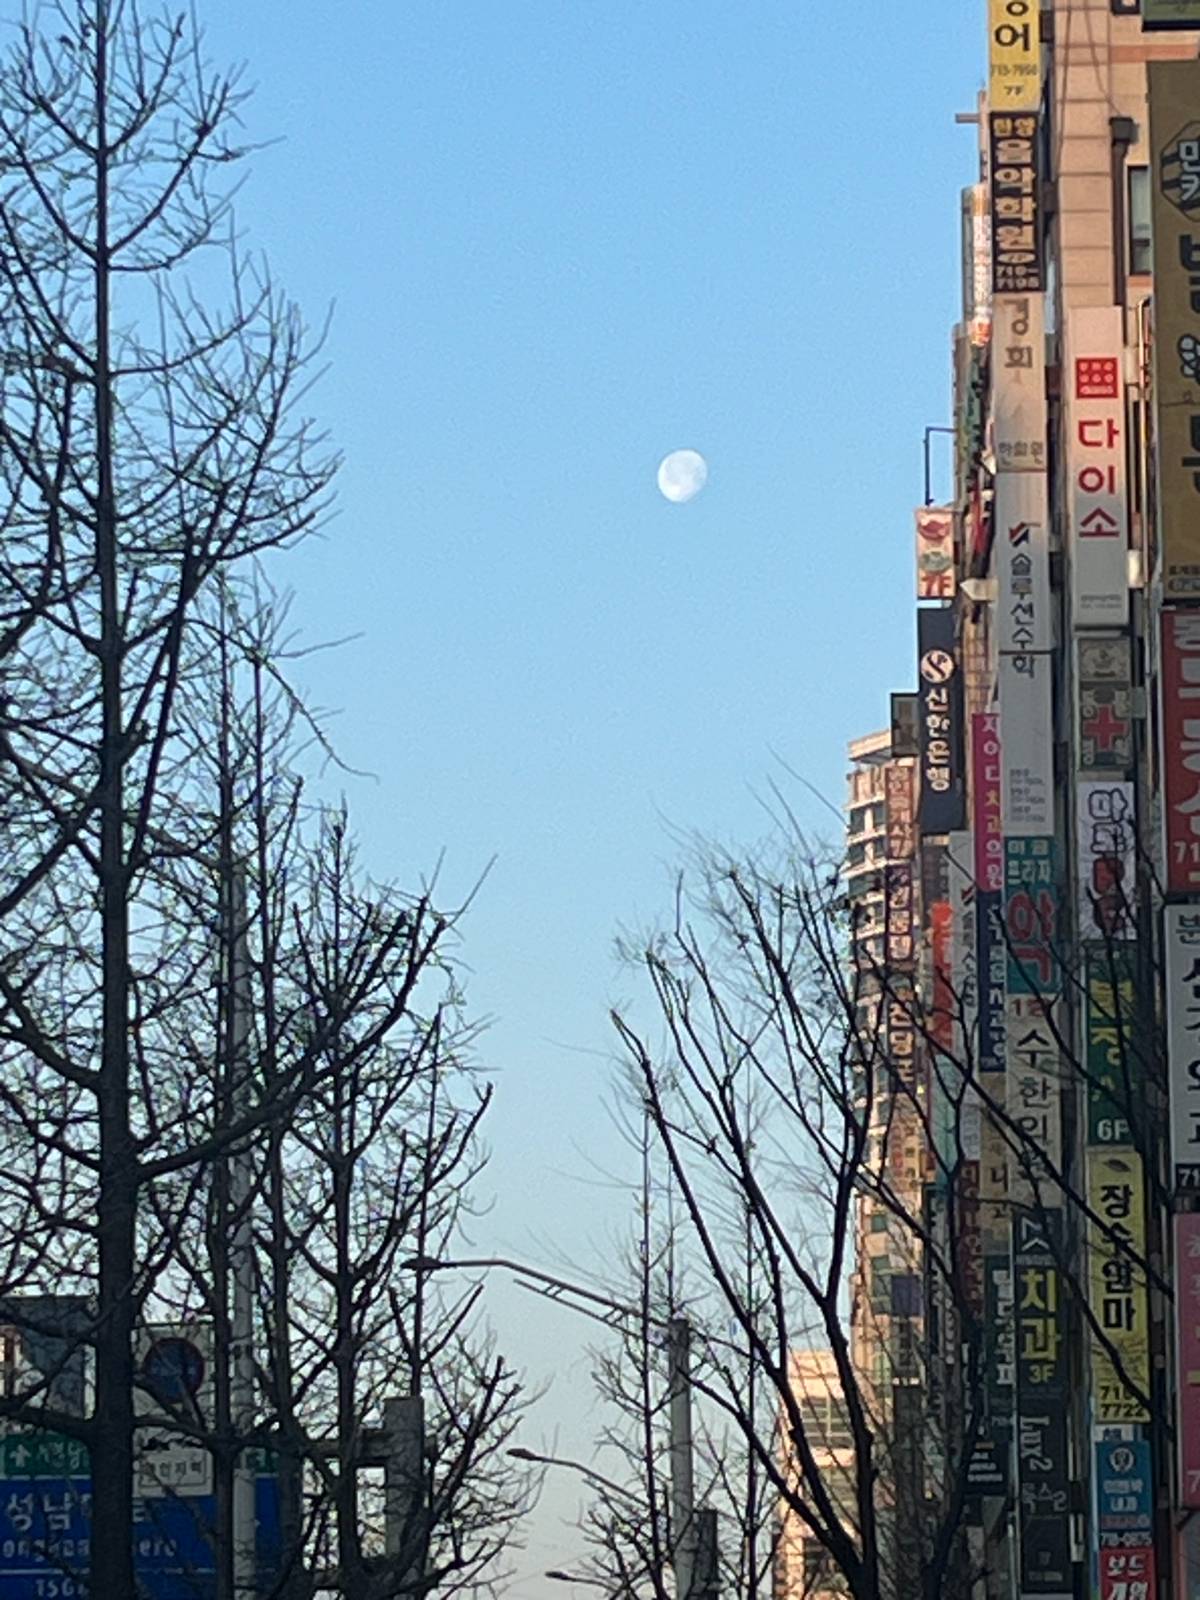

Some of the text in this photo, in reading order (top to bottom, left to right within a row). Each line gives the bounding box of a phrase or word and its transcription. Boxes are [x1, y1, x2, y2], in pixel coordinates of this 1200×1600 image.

[1078, 418, 1120, 538] 다이소
[921, 575, 952, 597] 7F
[1020, 1269, 1062, 1362] 치과
[1029, 1365, 1055, 1383] 3F
[5, 1492, 74, 1532] 성남
